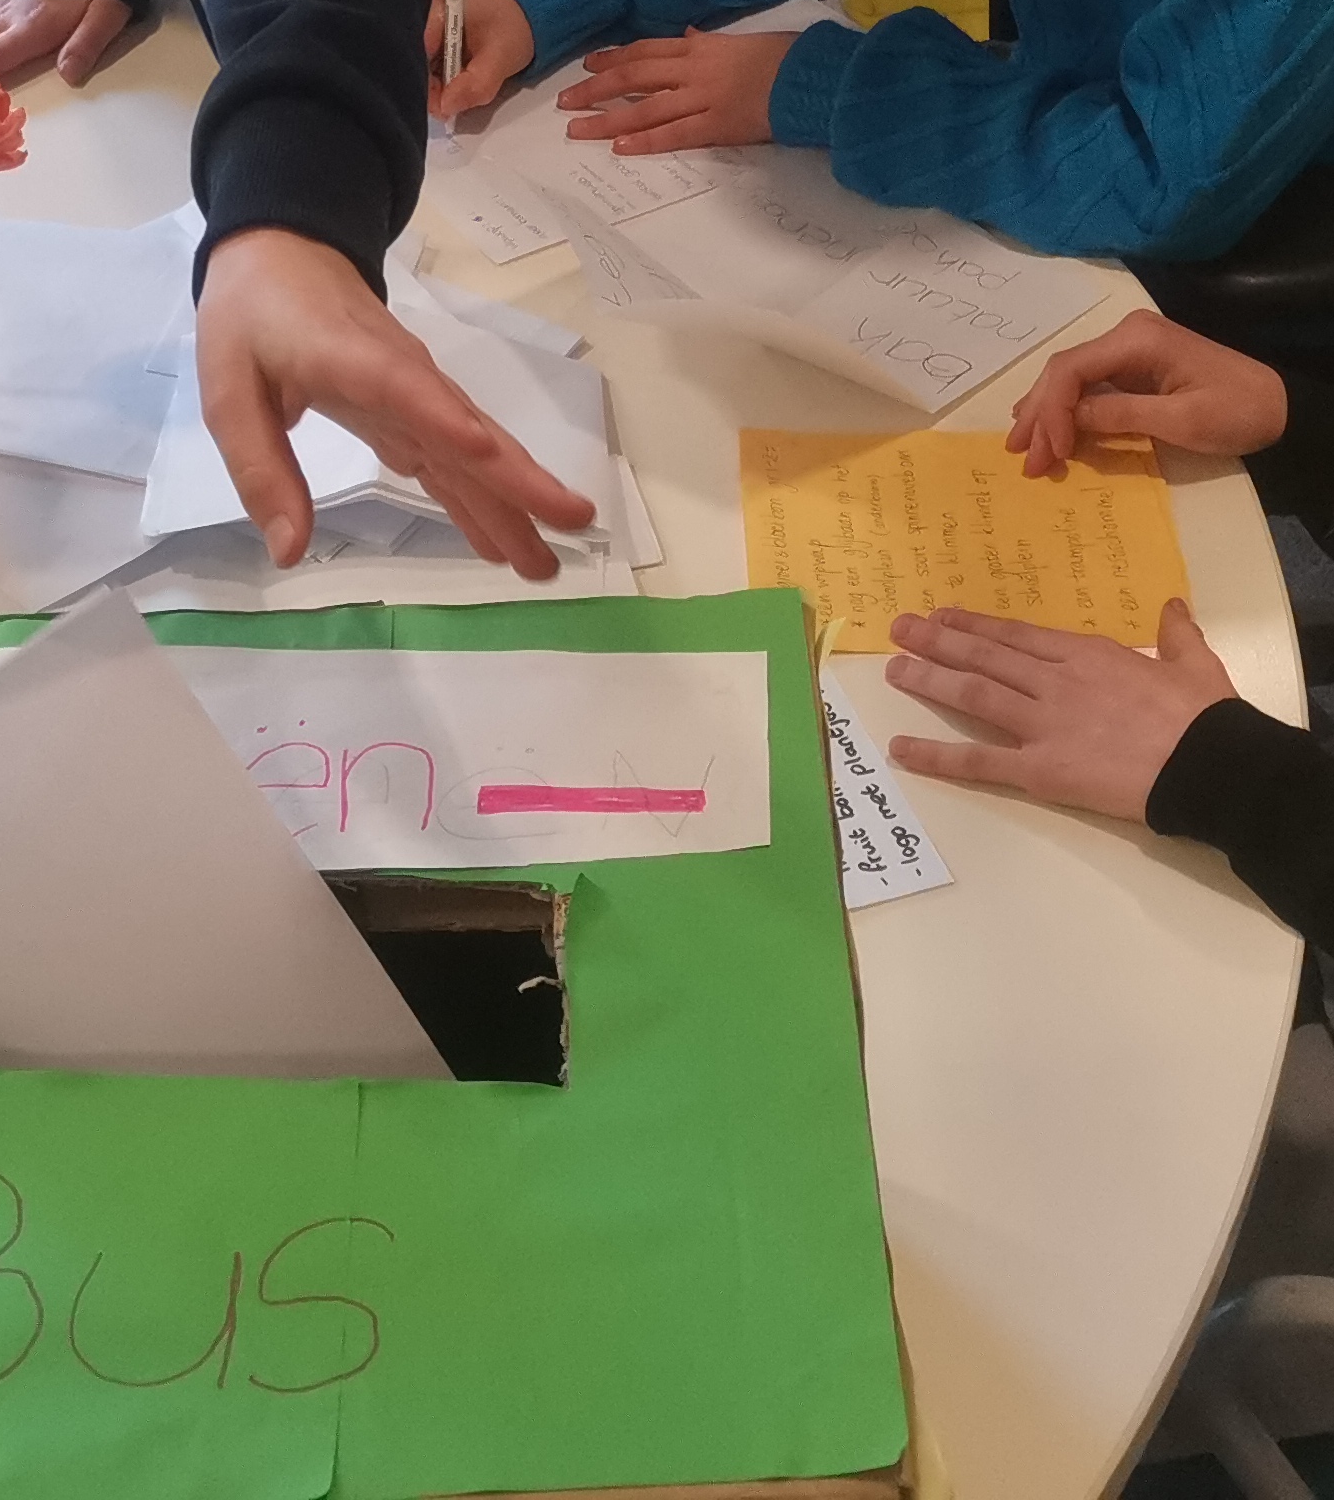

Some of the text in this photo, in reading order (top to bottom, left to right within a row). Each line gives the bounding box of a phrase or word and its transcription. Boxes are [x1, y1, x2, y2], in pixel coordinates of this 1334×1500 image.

[868, 270, 1037, 343] natuur
[850, 316, 973, 395] bak
[1052, 507, 1095, 582] trampoline
[860, 783, 897, 820] met
[849, 828, 888, 874] fruit
[890, 825, 921, 866] logo
